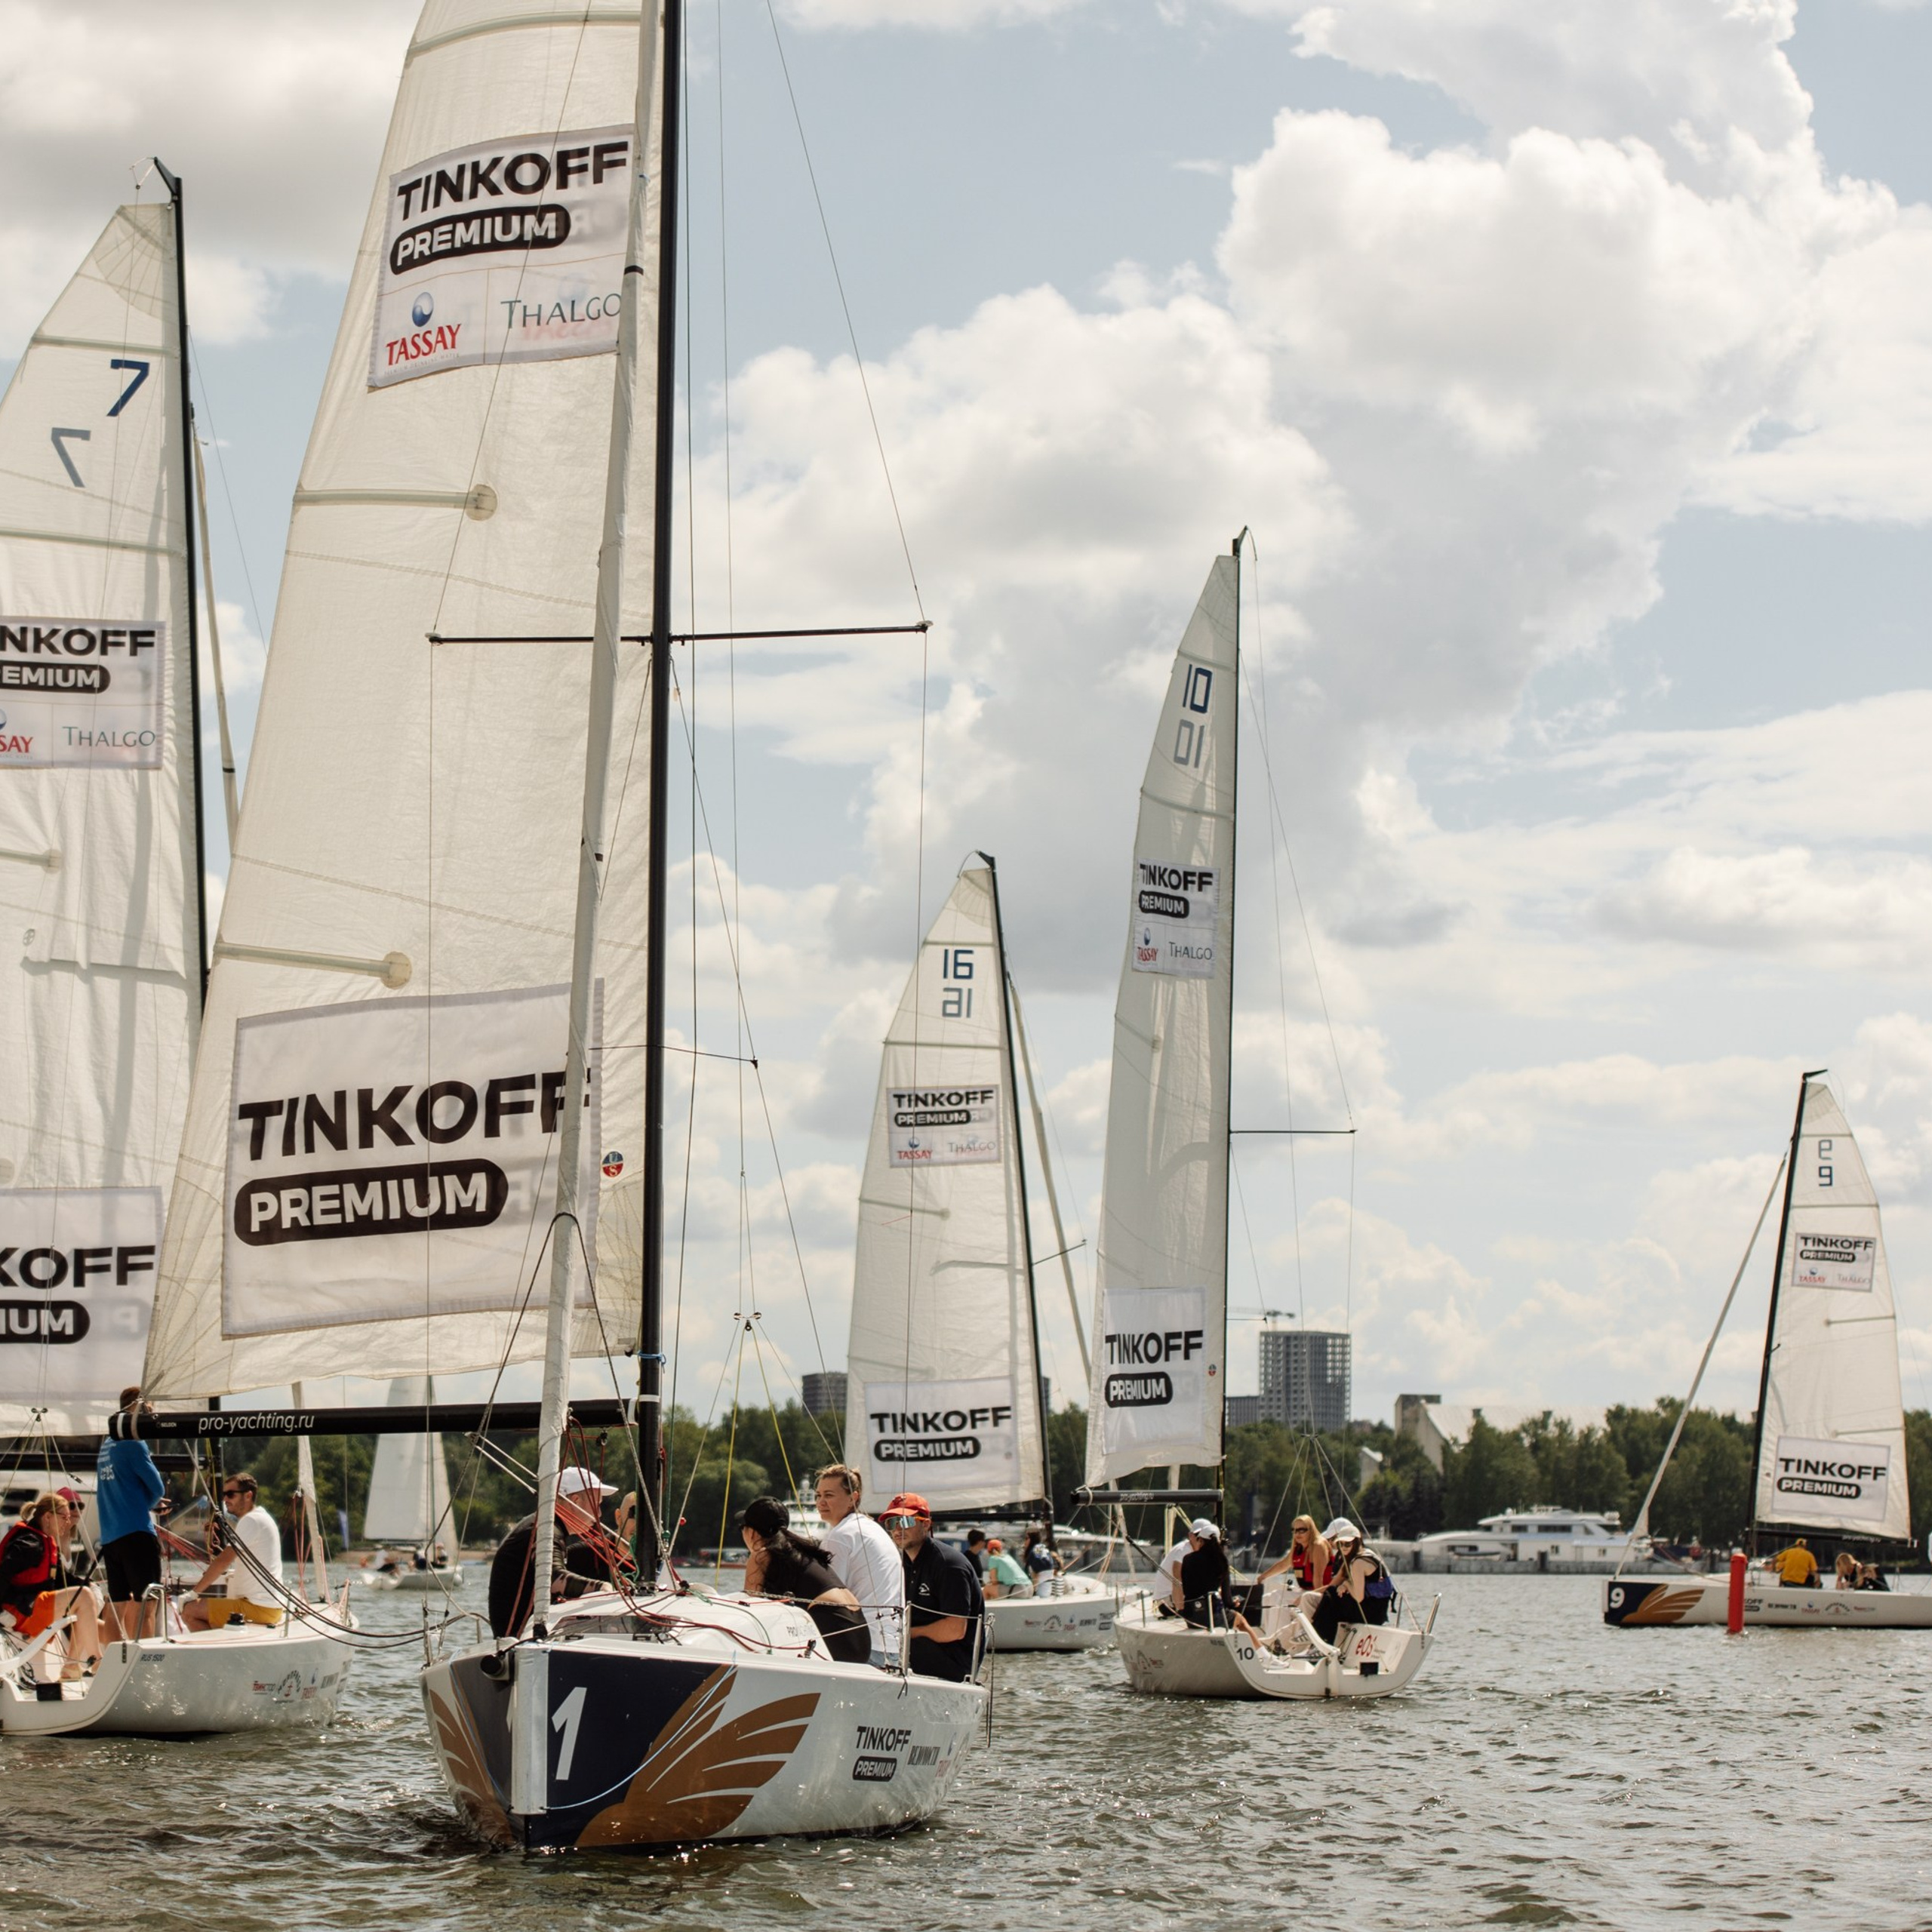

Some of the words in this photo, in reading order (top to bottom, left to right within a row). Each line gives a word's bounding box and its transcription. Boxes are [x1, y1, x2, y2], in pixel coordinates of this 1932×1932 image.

[397, 141, 629, 221] TINKOFF
[396, 212, 556, 266] PREMIUM
[500, 293, 621, 329] THALGO
[386, 324, 462, 366] TASSAY
[106, 359, 149, 417] 7
[1182, 664, 1213, 714] 10
[63, 726, 155, 747] THALGO
[1140, 863, 1214, 892] TINKOFF
[1168, 941, 1213, 960] THALGO
[943, 949, 974, 979] 16
[893, 1090, 994, 1108] TINKOFF
[238, 1068, 591, 1161] TINKOFF
[897, 1112, 967, 1124] PREMIUM
[897, 1149, 933, 1160] TASSAY
[250, 1172, 487, 1232] PREMIUM
[1801, 1236, 1873, 1251] TINKOFF
[1802, 1252, 1853, 1262] PREMIUM
[1105, 1330, 1203, 1364] TINKOFF
[1109, 1378, 1167, 1401] PREMIUM
[198, 1413, 314, 1433] pro-yachting.ru
[869, 1406, 1012, 1433] TINKOFF
[881, 1441, 974, 1458] PREMIUM
[1779, 1458, 1887, 1481] TINKOFF
[1781, 1479, 1857, 1497] PREMIUM
[1610, 1588, 1625, 1608] 9
[1236, 1647, 1254, 1660] 10
[552, 1687, 587, 1780] 1
[856, 1726, 912, 1752] TINKOFF
[854, 1761, 895, 1777] PREMIUM
